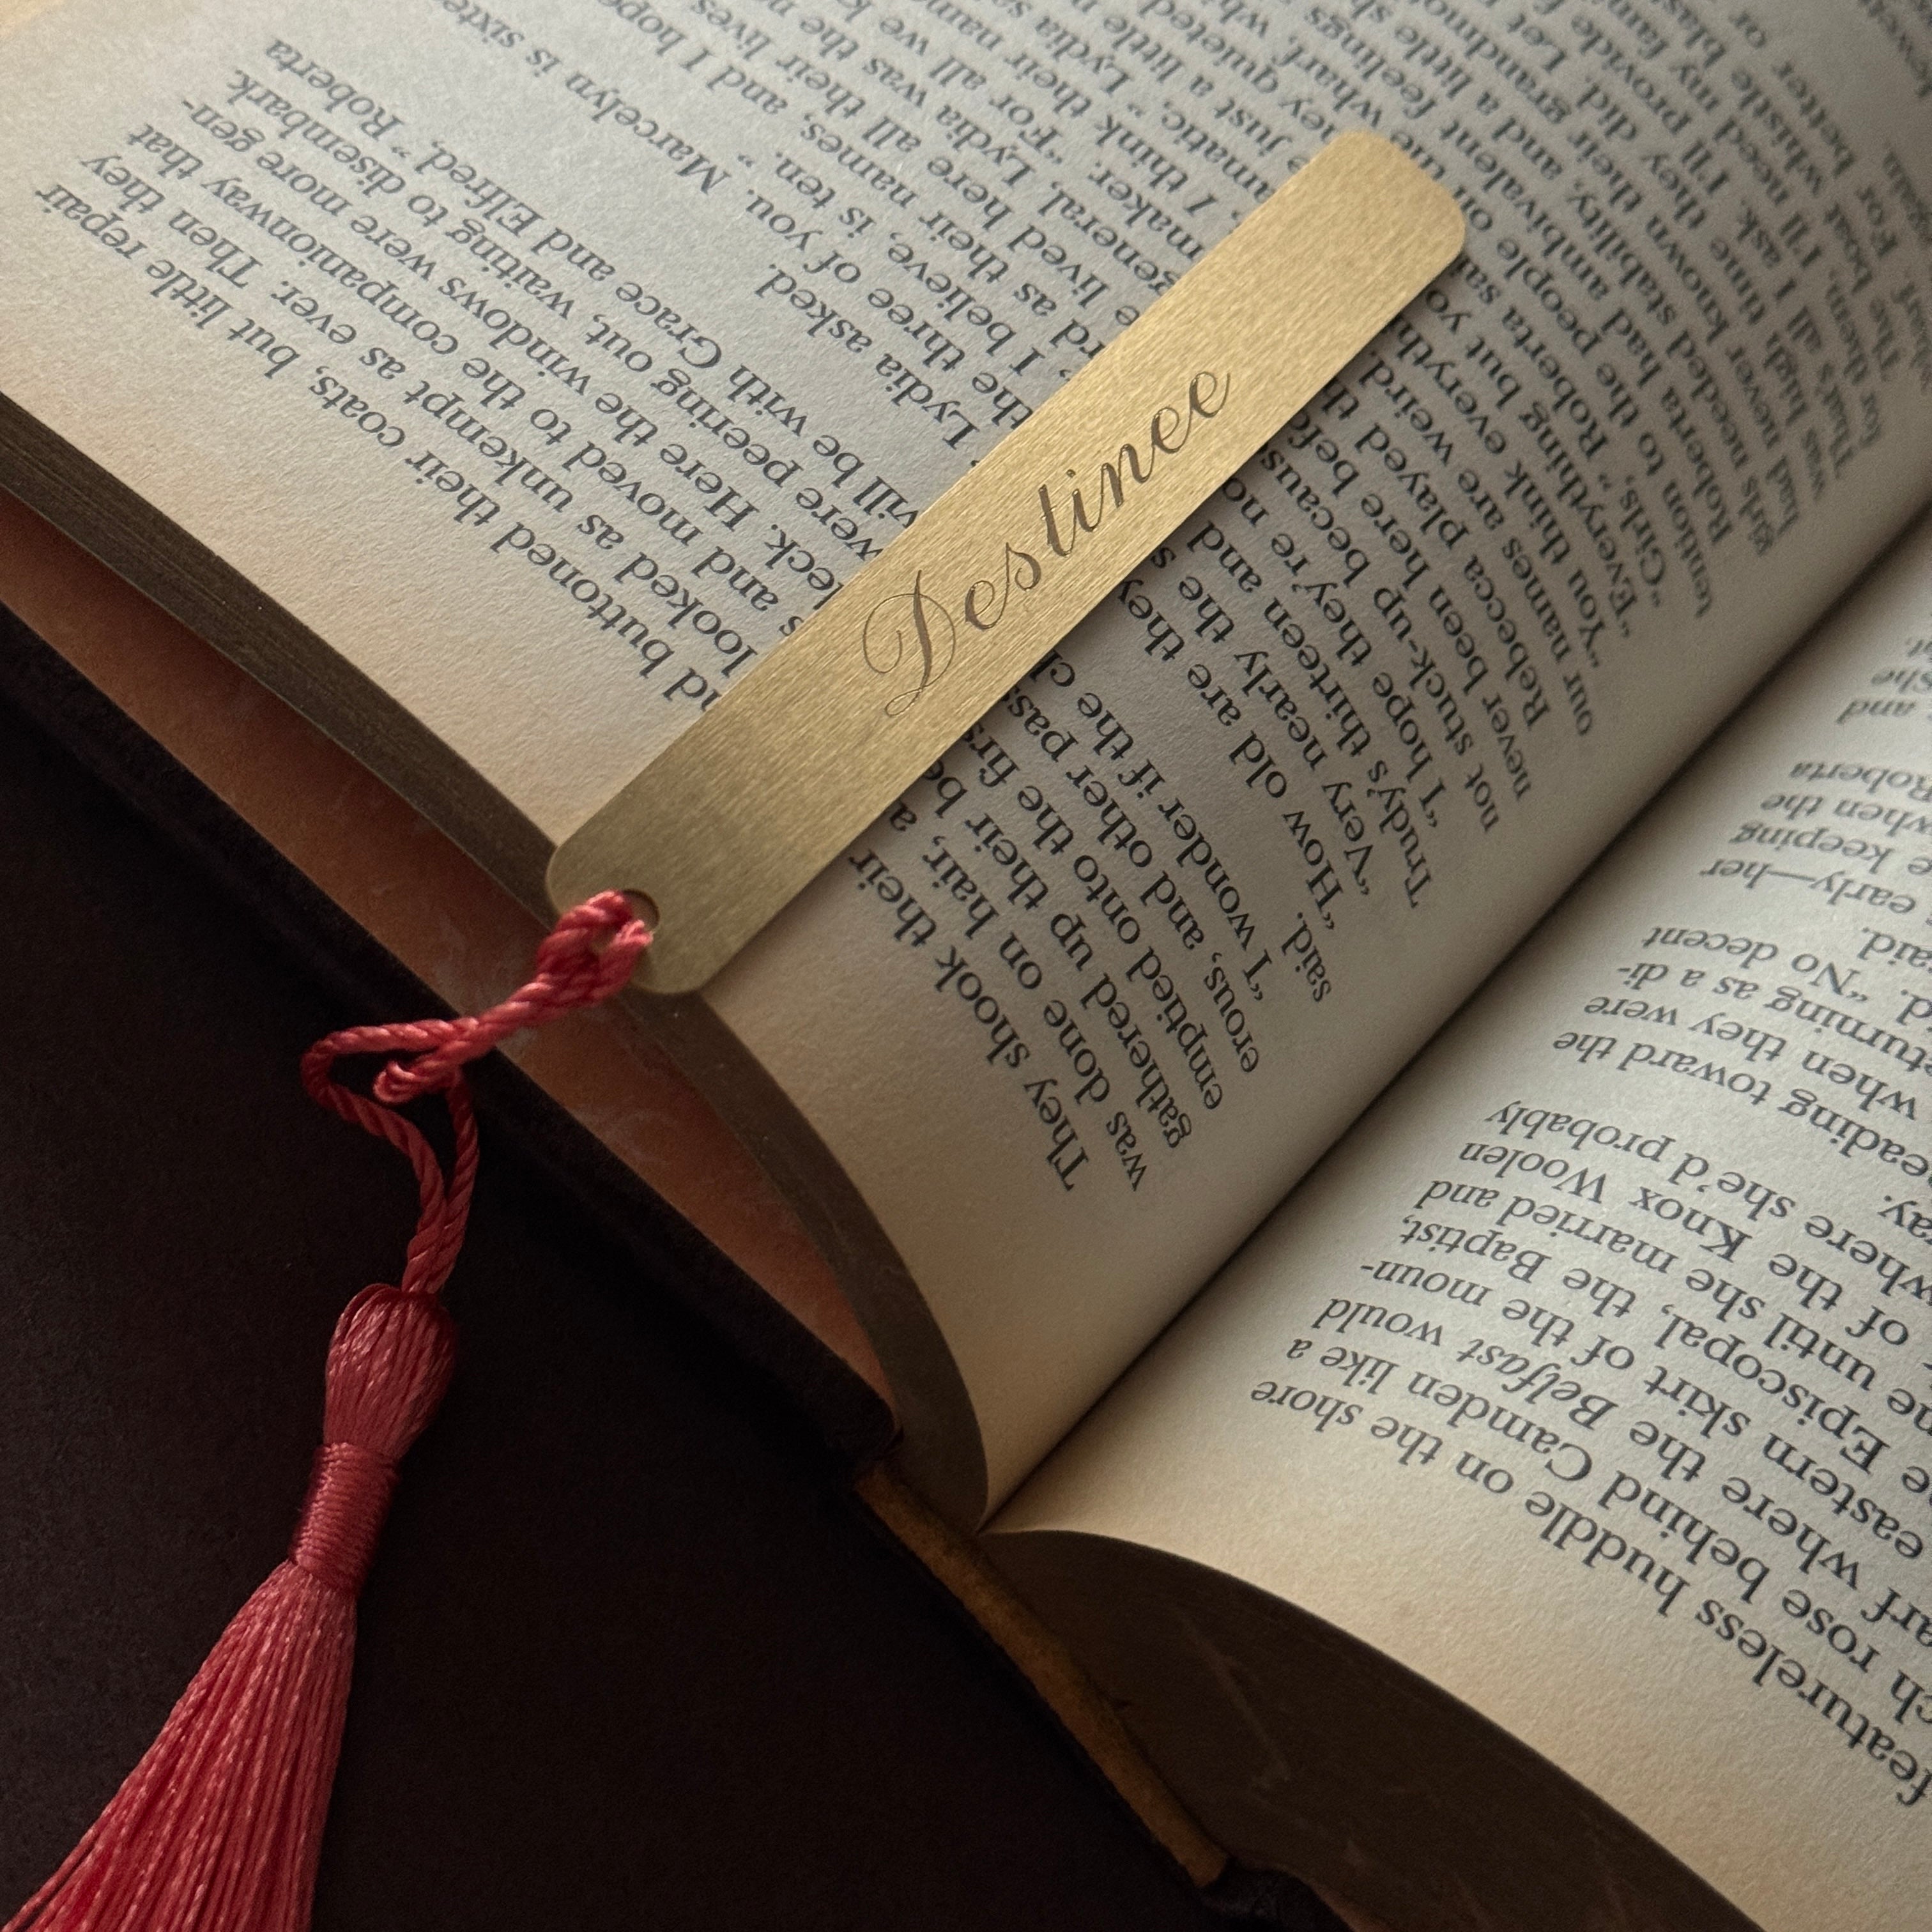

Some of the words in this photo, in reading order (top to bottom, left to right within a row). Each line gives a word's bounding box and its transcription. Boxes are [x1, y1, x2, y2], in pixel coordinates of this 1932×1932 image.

[264, 37, 406, 142] Roberta
[705, 63, 790, 116] and
[774, 53, 868, 120] their
[126, 122, 205, 181] that
[180, 98, 267, 153] gen-
[226, 68, 407, 198] disembark.
[564, 70, 732, 195] Marcelyn
[799, 112, 919, 210] names,
[79, 153, 167, 215] they
[254, 150, 354, 218] more
[406, 193, 450, 229] to
[744, 188, 825, 252] you.
[926, 158, 1013, 233] here
[33, 183, 149, 261] repair
[167, 208, 264, 290] Then
[348, 214, 438, 282] were
[528, 226, 617, 283] and
[838, 206, 876, 240] is
[917, 210, 1010, 284] their
[144, 258, 234, 331] little
[199, 176, 460, 356] companionway
[443, 217, 576, 321] waiting
[801, 249, 862, 285] of
[886, 231, 1018, 358] believe,
[1006, 223, 1110, 310] lived
[1012, 281, 1058, 318] as
[269, 279, 358, 346] ever.
[436, 276, 592, 397] windows
[583, 312, 654, 374] out,
[614, 280, 723, 371] Grace
[753, 262, 874, 355] asked.
[866, 287, 967, 373] three
[226, 316, 302, 381] but
[357, 346, 407, 381] as
[461, 356, 527, 411] the
[307, 364, 407, 449] coats,
[528, 407, 573, 447] to
[594, 391, 659, 448] the
[648, 367, 805, 489] peering
[726, 363, 809, 438] with
[874, 351, 981, 451] Lydia
[402, 379, 574, 514] unkempt
[811, 433, 866, 490] be
[403, 449, 502, 528] their
[560, 440, 704, 548] moved
[658, 442, 761, 533] Here
[575, 513, 626, 551] as
[862, 370, 1231, 719] Destinee
[1184, 518, 1264, 594] and
[488, 520, 676, 680] buttoned
[612, 551, 759, 680] looked
[689, 544, 780, 613] and
[1177, 575, 1236, 645] the
[1186, 663, 1243, 728] are
[1262, 596, 1372, 758] thirteen
[1372, 586, 1475, 757] stuck-up
[1076, 691, 1135, 762] the
[1232, 650, 1329, 772] nearly
[1371, 671, 1434, 784] hope
[1116, 758, 1167, 801] if
[1227, 729, 1289, 800] old
[1016, 784, 1075, 857] the
[1064, 763, 1154, 870] other
[850, 848, 938, 949] their
[921, 834, 1000, 941] hair,
[963, 812, 1050, 912] their
[1156, 797, 1257, 952] wonder
[1072, 854, 1142, 946] onto
[1138, 869, 1206, 952] and
[998, 931, 1044, 991] on
[1049, 912, 1094, 973] up
[1280, 910, 1333, 1004] said.
[1616, 962, 1671, 992] di-
[1641, 926, 1780, 971] decent
[933, 944, 1032, 1070] shook
[1202, 951, 1261, 1075] erous,
[1583, 995, 1678, 1027] were
[1711, 976, 1761, 1001] as
[1042, 999, 1112, 1107] done
[1078, 972, 1193, 1150] gathered
[1124, 945, 1224, 1111] emptied
[1551, 1031, 1619, 1065] the
[1687, 1011, 1788, 1064] they
[1616, 1041, 1773, 1107] toward
[1800, 1049, 1917, 1122] when
[1022, 1077, 1091, 1193] They
[1104, 1110, 1148, 1193] was
[1483, 1099, 1678, 1164] probably
[1413, 1179, 1501, 1211] and
[1457, 1141, 1607, 1206] Woolen
[1399, 1215, 1553, 1285] Baptist,
[1494, 1195, 1680, 1275] married
[1627, 1185, 1754, 1264] Knox
[1359, 1259, 1494, 1308] moun-
[1561, 1267, 1637, 1319] the
[1684, 1268, 1767, 1324] she
[1767, 1252, 1844, 1312] the
[1310, 1297, 1444, 1348] would
[1500, 1298, 1576, 1349] the
[1568, 1334, 1636, 1372] of
[1762, 1312, 1878, 1393] until
[1844, 1305, 1911, 1347] of
[1249, 1380, 1365, 1434] shore
[1318, 1346, 1400, 1397] like
[1455, 1337, 1620, 1432] Belfast
[1643, 1365, 1752, 1440] skirt
[1653, 1303, 1892, 1476] Episcopal,
[1368, 1415, 1445, 1468] the
[1406, 1370, 1594, 1483] Camden
[1628, 1420, 1707, 1483] the
[1454, 1450, 1515, 1496] on
[1761, 1431, 1925, 1561] eastern
[1524, 1490, 1692, 1619] huddle
[1596, 1469, 1772, 1606] behind
[1720, 1476, 1860, 1591] where
[1781, 1588, 1882, 1675] rose
[1694, 1598, 1932, 1808] featureless
